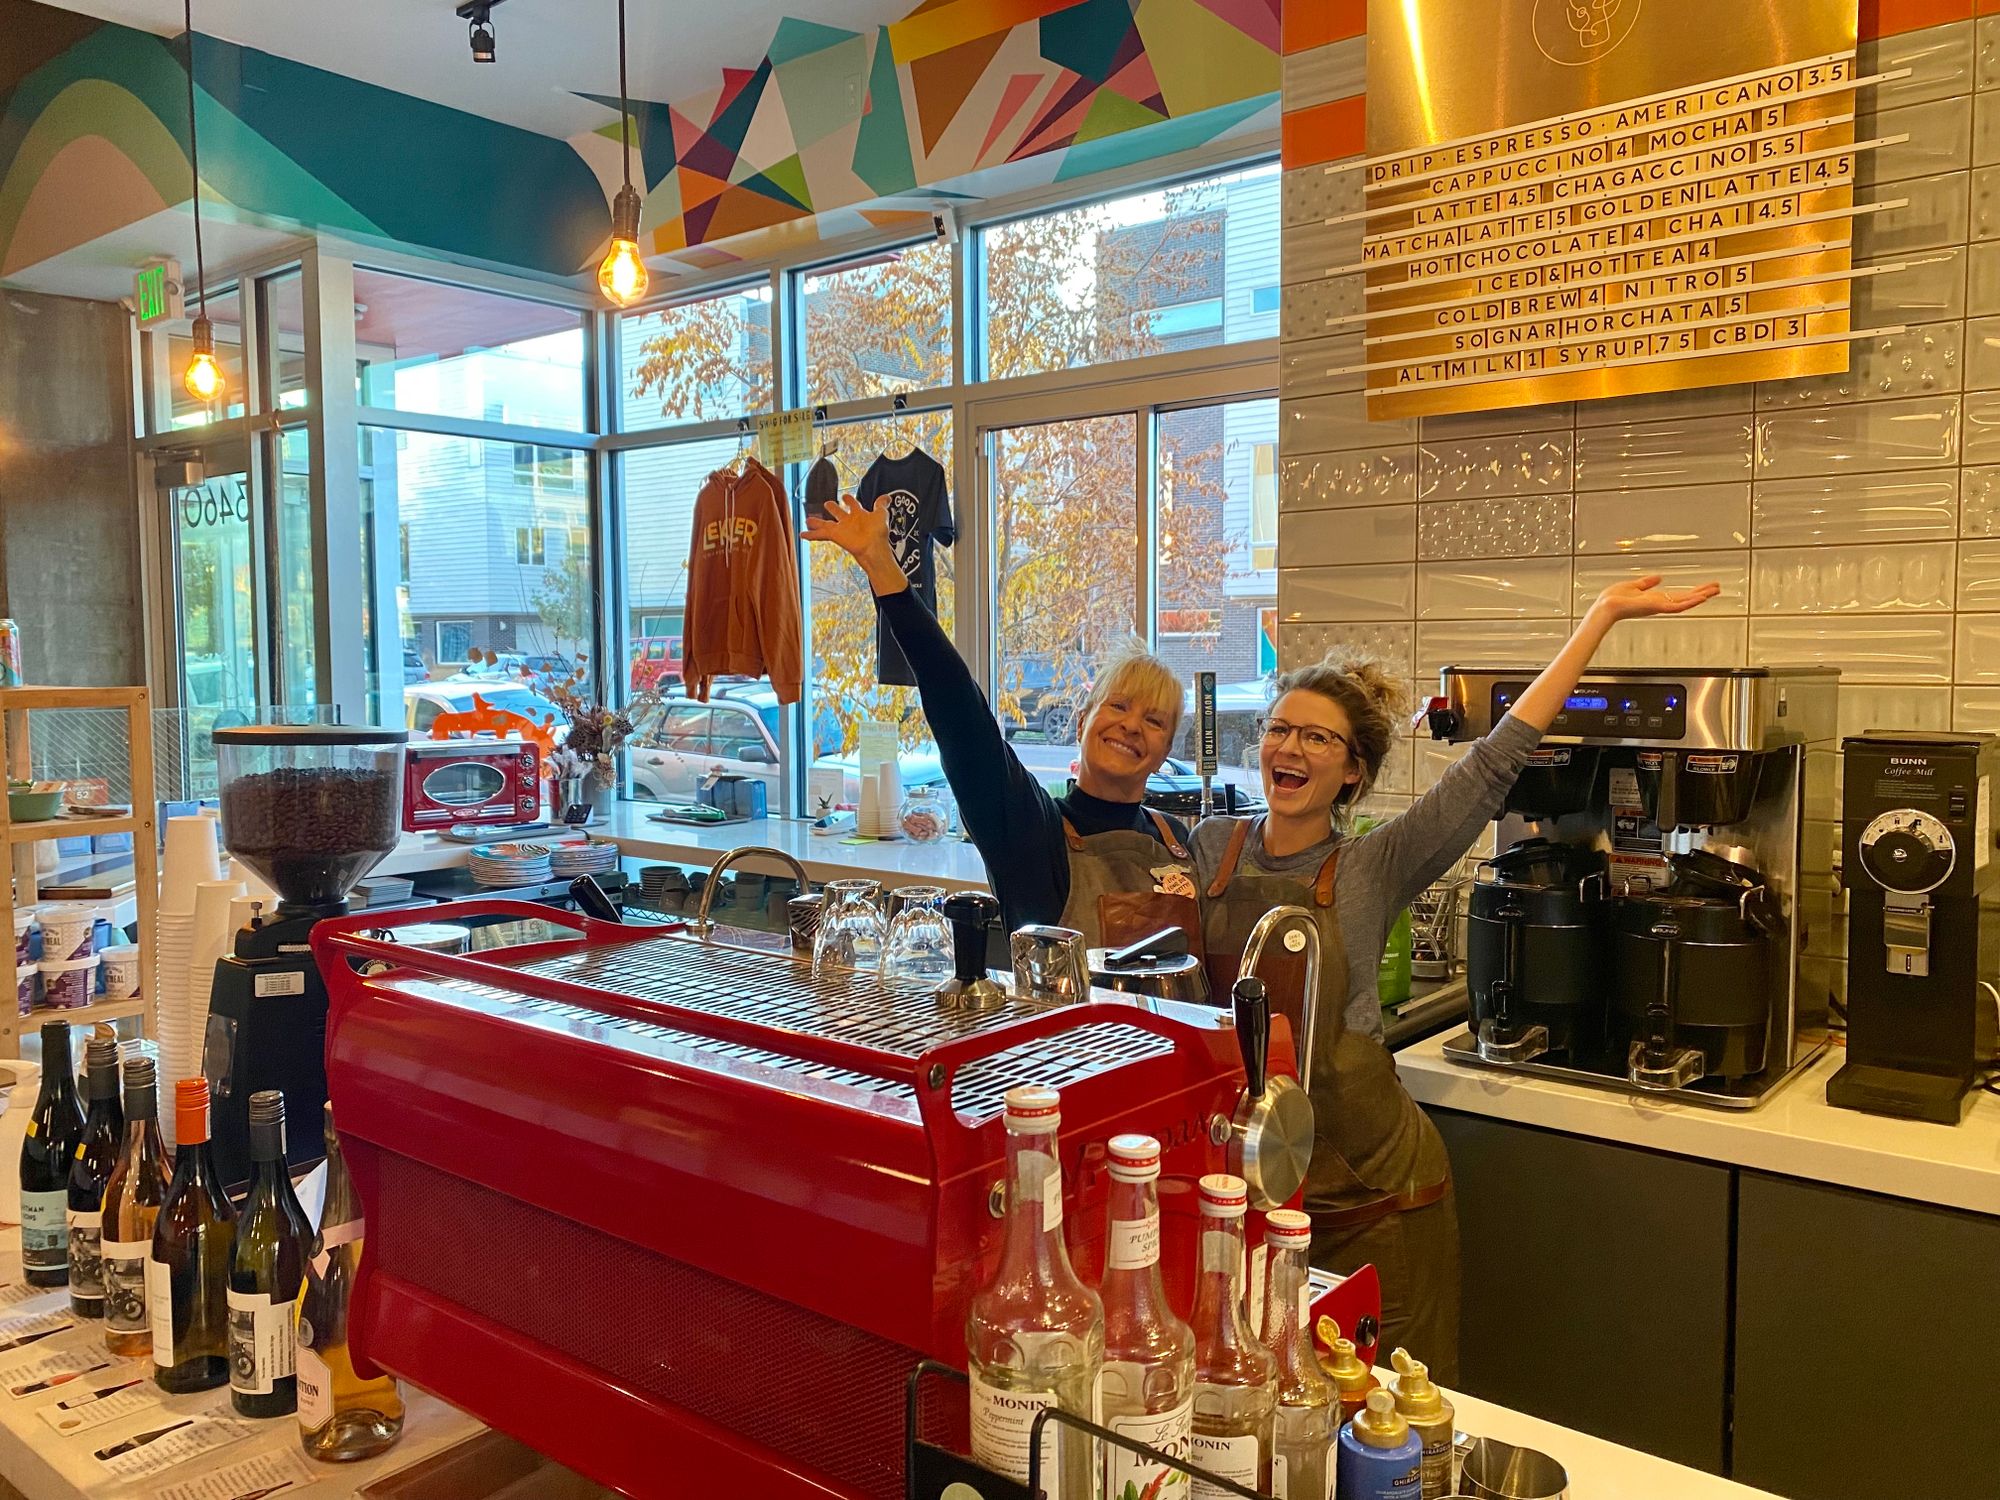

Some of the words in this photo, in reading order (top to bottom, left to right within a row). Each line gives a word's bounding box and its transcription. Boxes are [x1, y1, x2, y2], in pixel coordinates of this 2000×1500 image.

[1375, 156, 1433, 181] DRIP
[1456, 121, 1592, 164] ESPRESSO
[1616, 76, 1794, 129] AMERICANO
[1808, 64, 1843, 86] 3.5
[1433, 147, 1603, 195] CAPPUCCINO
[1616, 143, 1628, 157] 4
[1651, 117, 1749, 151] MOCHA
[1767, 109, 1779, 127] 5
[1418, 197, 1493, 225] LATTE
[1508, 188, 1536, 207] 4.5
[1556, 147, 1746, 198] CHAGACCINO
[1762, 138, 1795, 158] 5.5
[1363, 231, 1455, 261] MATCHA
[1464, 214, 1545, 242] LATTE
[1556, 210, 1566, 226] 5
[1584, 186, 1695, 220] GOLDEN
[1705, 167, 1801, 200] LATTE
[1814, 157, 1850, 178] 4.5
[1410, 256, 1455, 278] HOT
[1464, 229, 1617, 269] CHOCOLATE
[1633, 225, 1645, 240] 4
[1669, 208, 1740, 234] CHAI
[1759, 199, 1793, 219] 4.5
[139, 264, 165, 320] EXIT
[1478, 271, 1538, 293] ICED
[1549, 267, 1561, 282] &
[1571, 257, 1621, 279] HOT
[1633, 247, 1685, 269] TEA
[1698, 242, 1710, 258] 4
[1438, 304, 1499, 325] COLD
[1512, 292, 1577, 315] BREW
[1588, 289, 1599, 304] 4
[1625, 271, 1719, 298] NITRO
[1735, 267, 1747, 283] 5
[1455, 333, 1483, 349] SO
[1493, 323, 1556, 344] GNAR
[1566, 302, 1713, 335] HORCHATA
[1725, 297, 1741, 315] .5
[1400, 365, 1442, 382] ALT
[1452, 355, 1514, 377] MILK
[1529, 352, 1537, 367] 1
[1559, 340, 1643, 363] SYRUP
[1655, 333, 1690, 354] .75
[1713, 324, 1769, 345] CBD
[1787, 320, 1799, 336] 3
[1204, 694, 1213, 716] NOVO
[1205, 730, 1214, 755] NITRO
[1890, 757, 1927, 765] BUNN
[76, 791, 89, 800] 52
[1884, 766, 1912, 776] Coffee
[1914, 767, 1934, 776] Mill
[983, 1407, 1024, 1426] Peppermint
[993, 1395, 1047, 1410] MONIN
